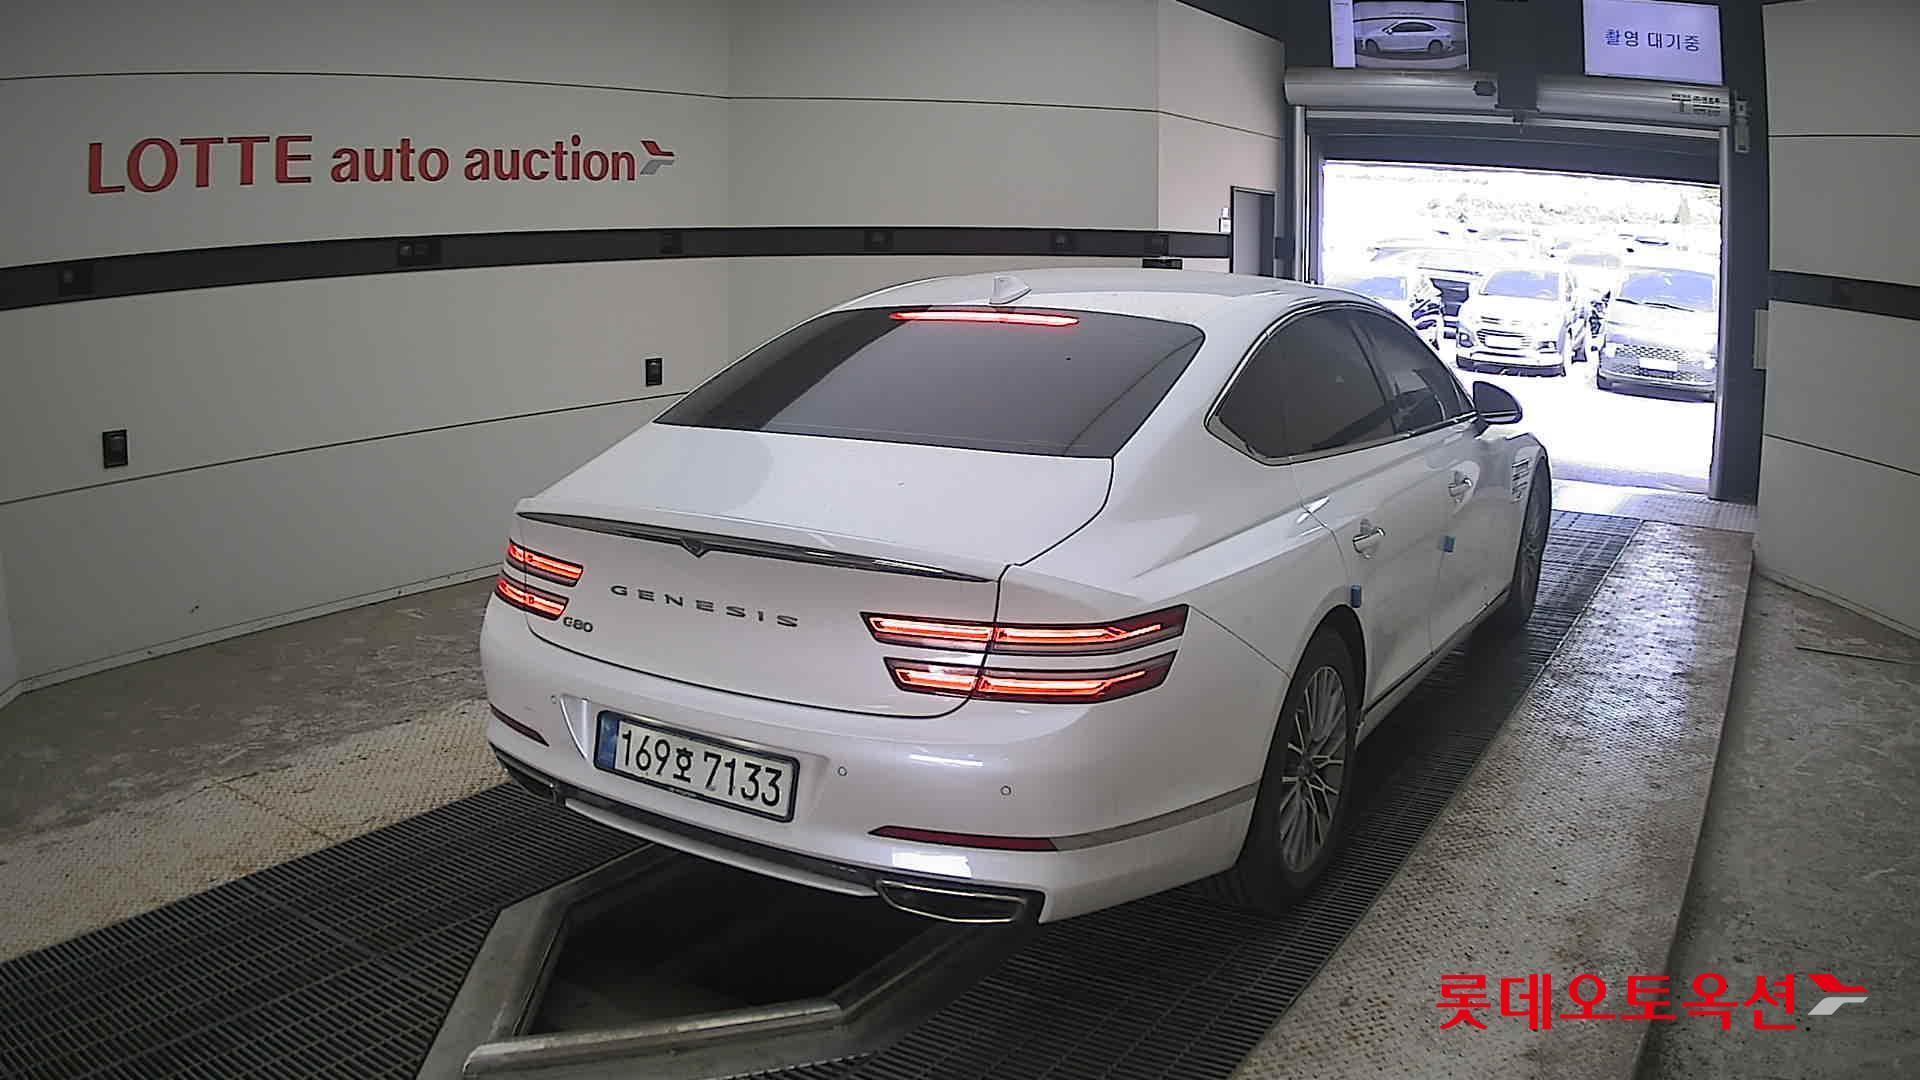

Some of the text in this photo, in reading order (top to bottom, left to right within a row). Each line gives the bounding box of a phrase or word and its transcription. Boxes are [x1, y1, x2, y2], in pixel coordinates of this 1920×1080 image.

[1605, 28, 1700, 52] 촬영 대기중
[88, 134, 637, 194] LOTTE auto auction
[562, 616, 594, 633] G80
[610, 585, 799, 628] GENESIS
[622, 729, 783, 807] 169호 7133
